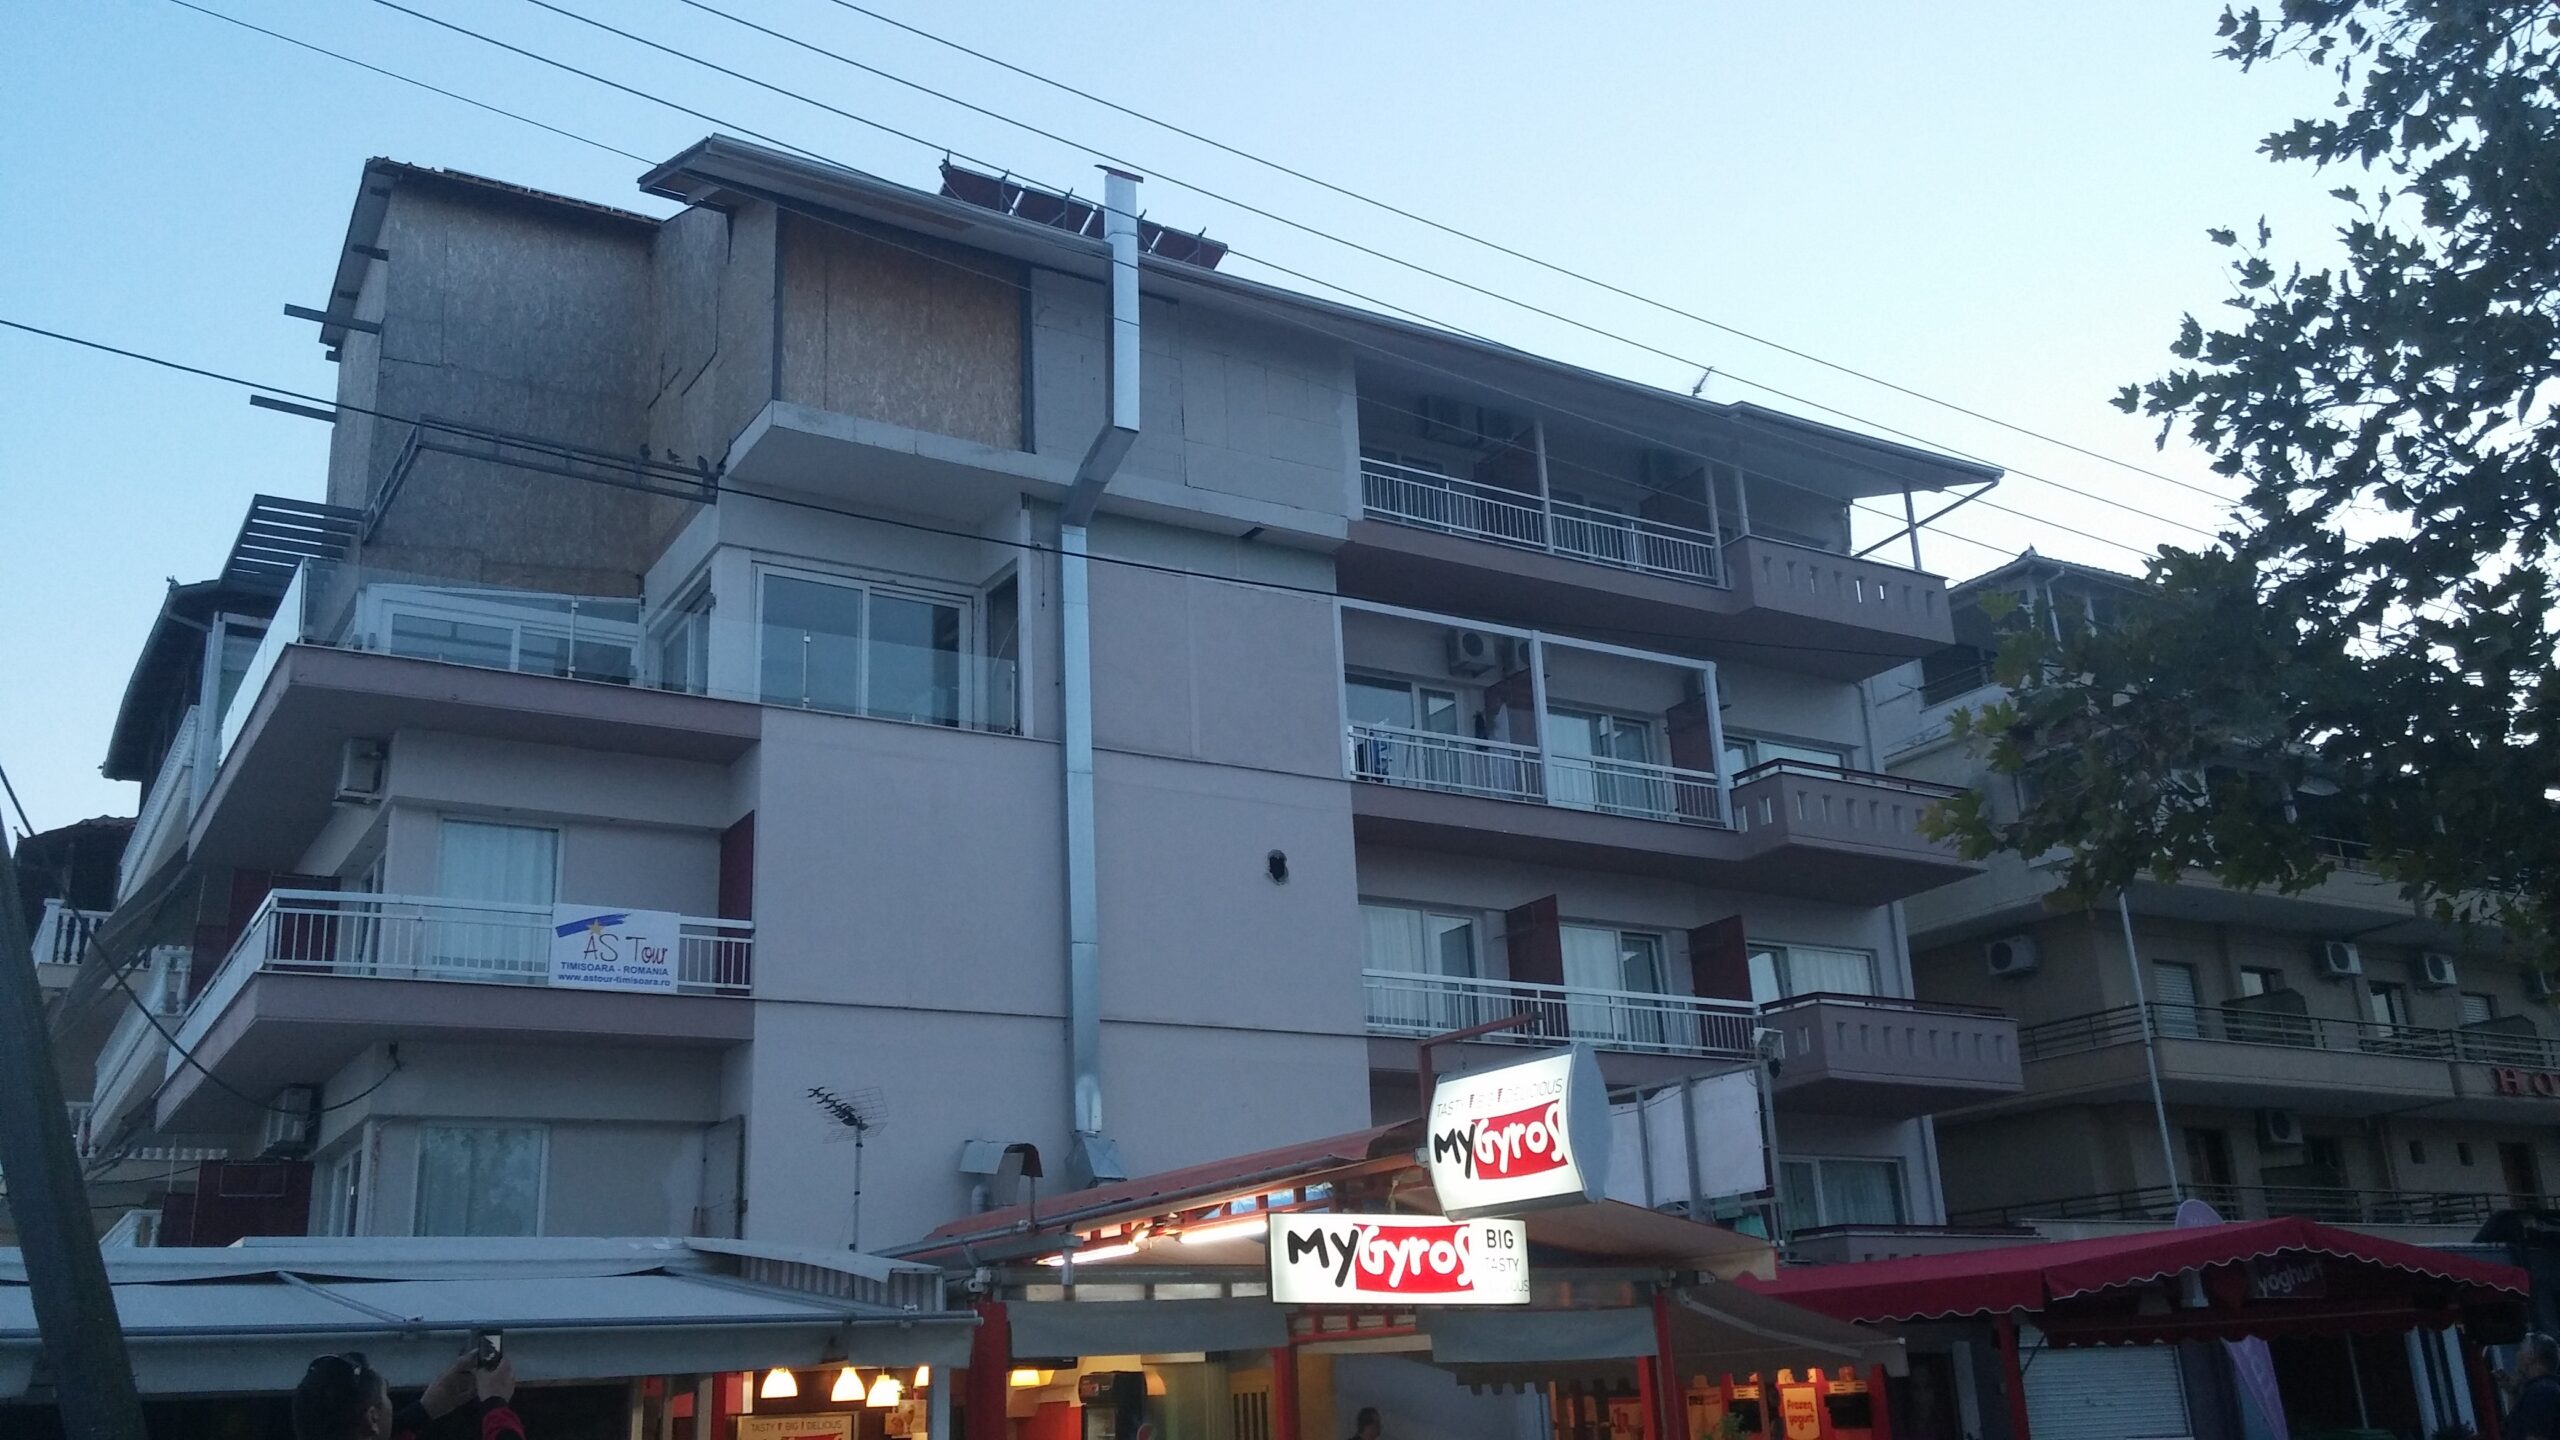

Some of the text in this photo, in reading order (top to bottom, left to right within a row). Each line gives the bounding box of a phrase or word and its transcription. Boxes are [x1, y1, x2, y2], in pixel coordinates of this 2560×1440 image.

[583, 934, 618, 962] AS
[560, 961, 615, 973] TIMISOARA
[623, 966, 668, 976] ROMANIA
[2491, 1067, 2560, 1097] HO
[1486, 1229, 1514, 1249] BIG
